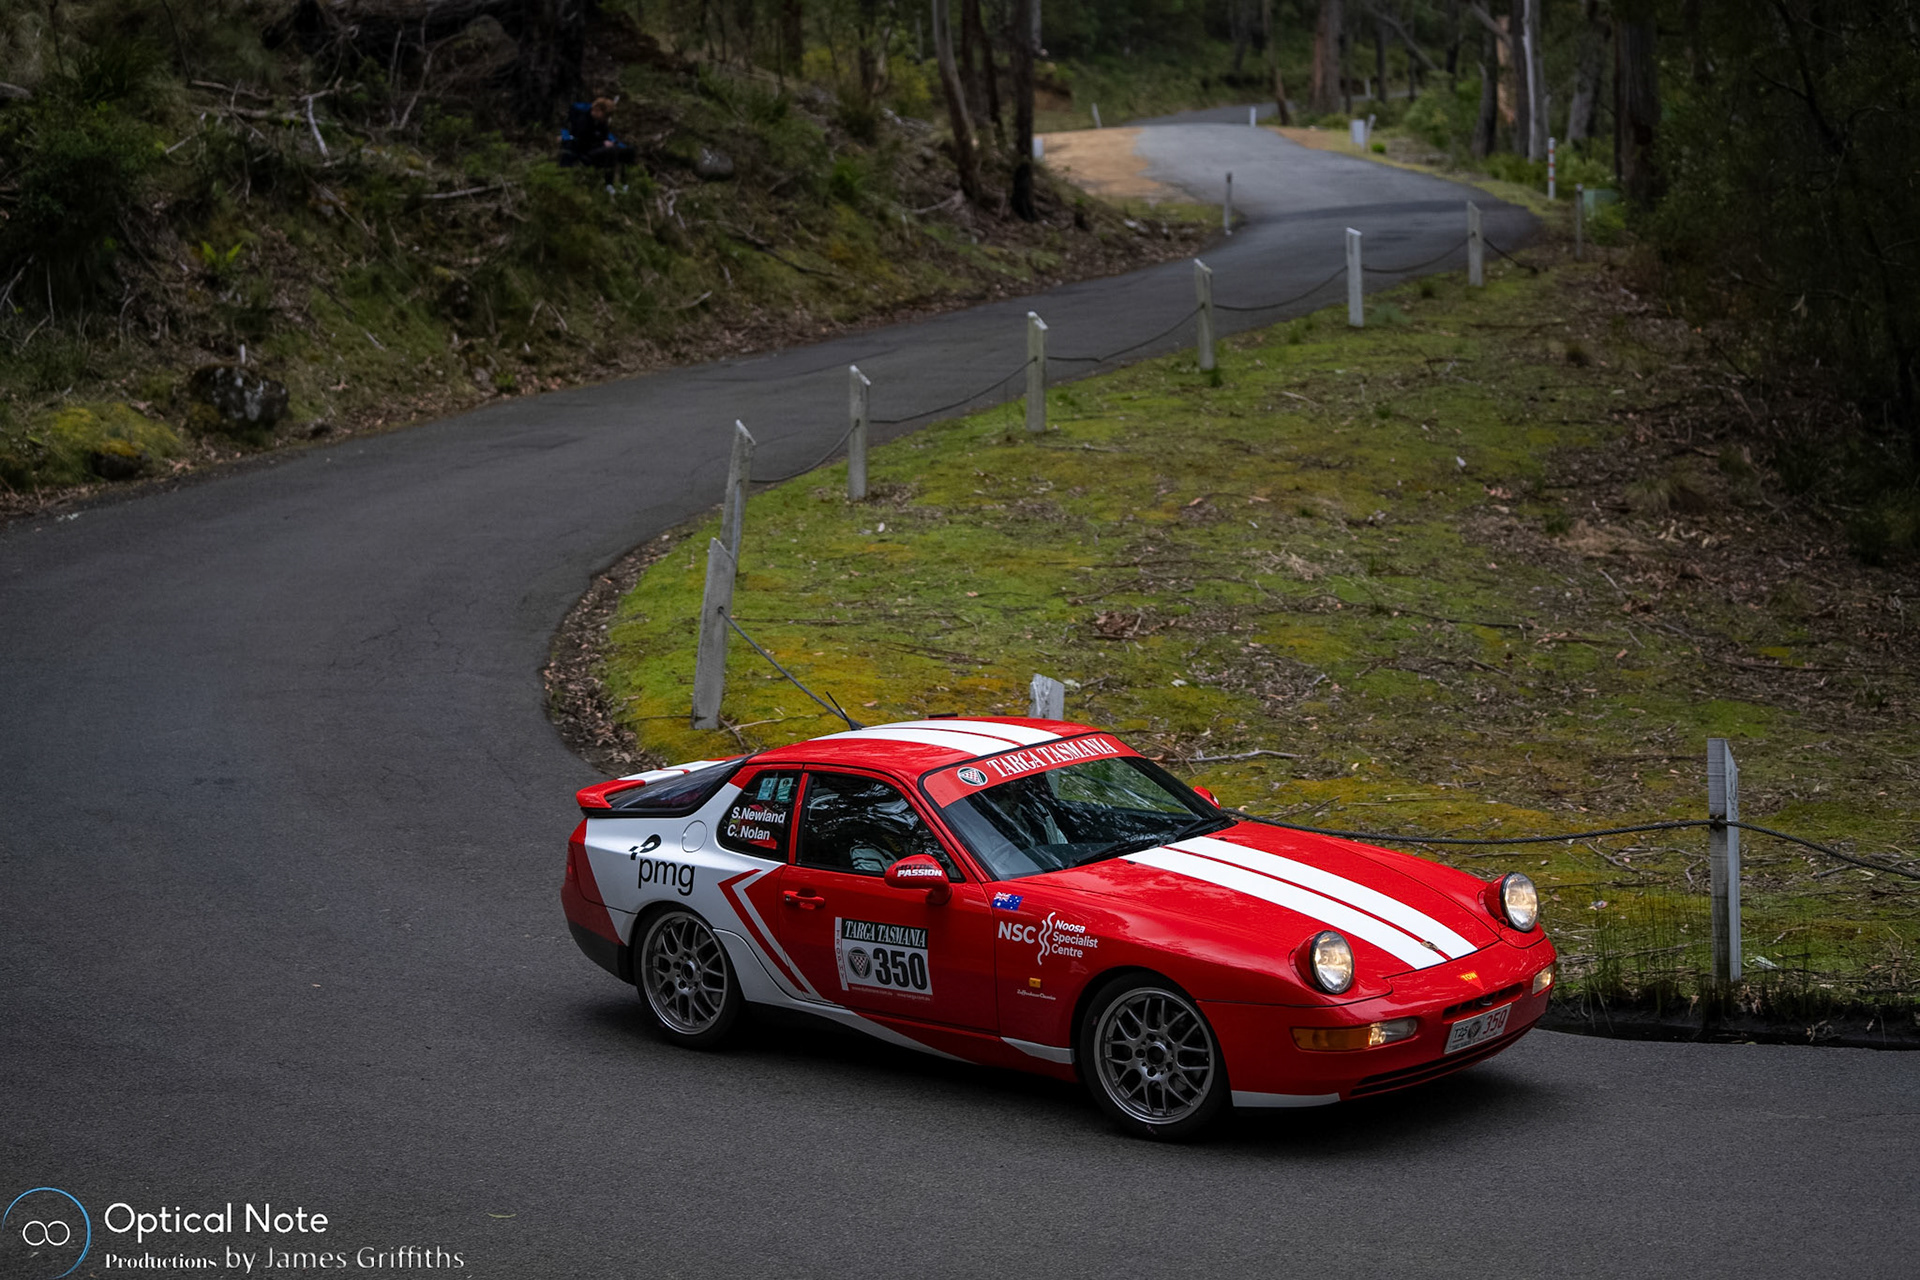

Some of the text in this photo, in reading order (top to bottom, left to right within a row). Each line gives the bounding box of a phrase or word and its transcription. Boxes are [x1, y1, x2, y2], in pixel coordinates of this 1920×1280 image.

[986, 737, 1119, 777] TARGA TASMANIA
[731, 806, 786, 824] S.Newland
[727, 824, 770, 841] C. Nolan
[638, 858, 696, 897] pmg
[897, 869, 943, 878] PASSION
[845, 920, 926, 947] TARGA TASMANIA
[997, 921, 1037, 944] NSC
[1054, 919, 1086, 933] Noosa
[1052, 931, 1098, 948] Specialist
[836, 929, 847, 980] TROPHY
[1051, 943, 1083, 958] Centre
[873, 947, 928, 990] 350
[1461, 972, 1478, 981] TOW
[1482, 1009, 1508, 1035] 350
